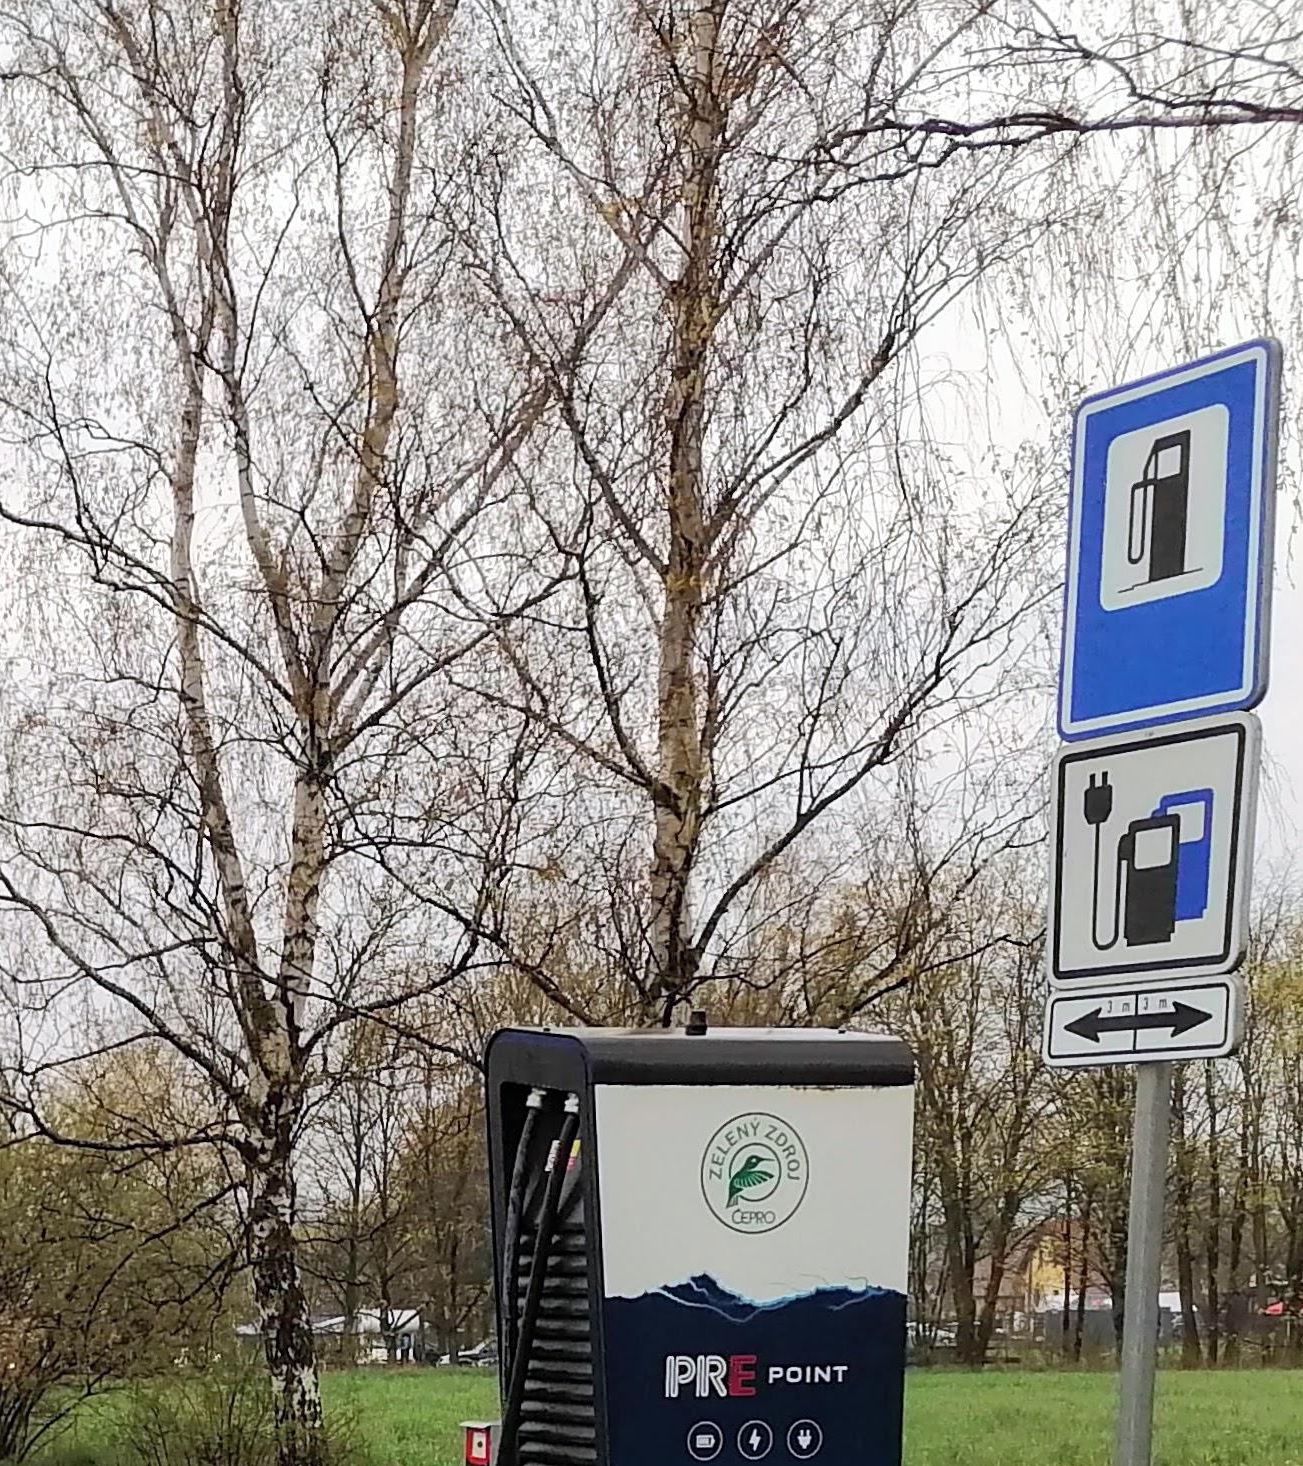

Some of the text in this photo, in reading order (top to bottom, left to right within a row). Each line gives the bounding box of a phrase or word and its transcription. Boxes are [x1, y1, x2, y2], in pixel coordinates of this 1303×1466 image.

[708, 1116, 801, 1181] ZELENÝ ZDROJ
[731, 1208, 776, 1225] ČEPRO
[665, 1355, 849, 1398] PRE POINT
